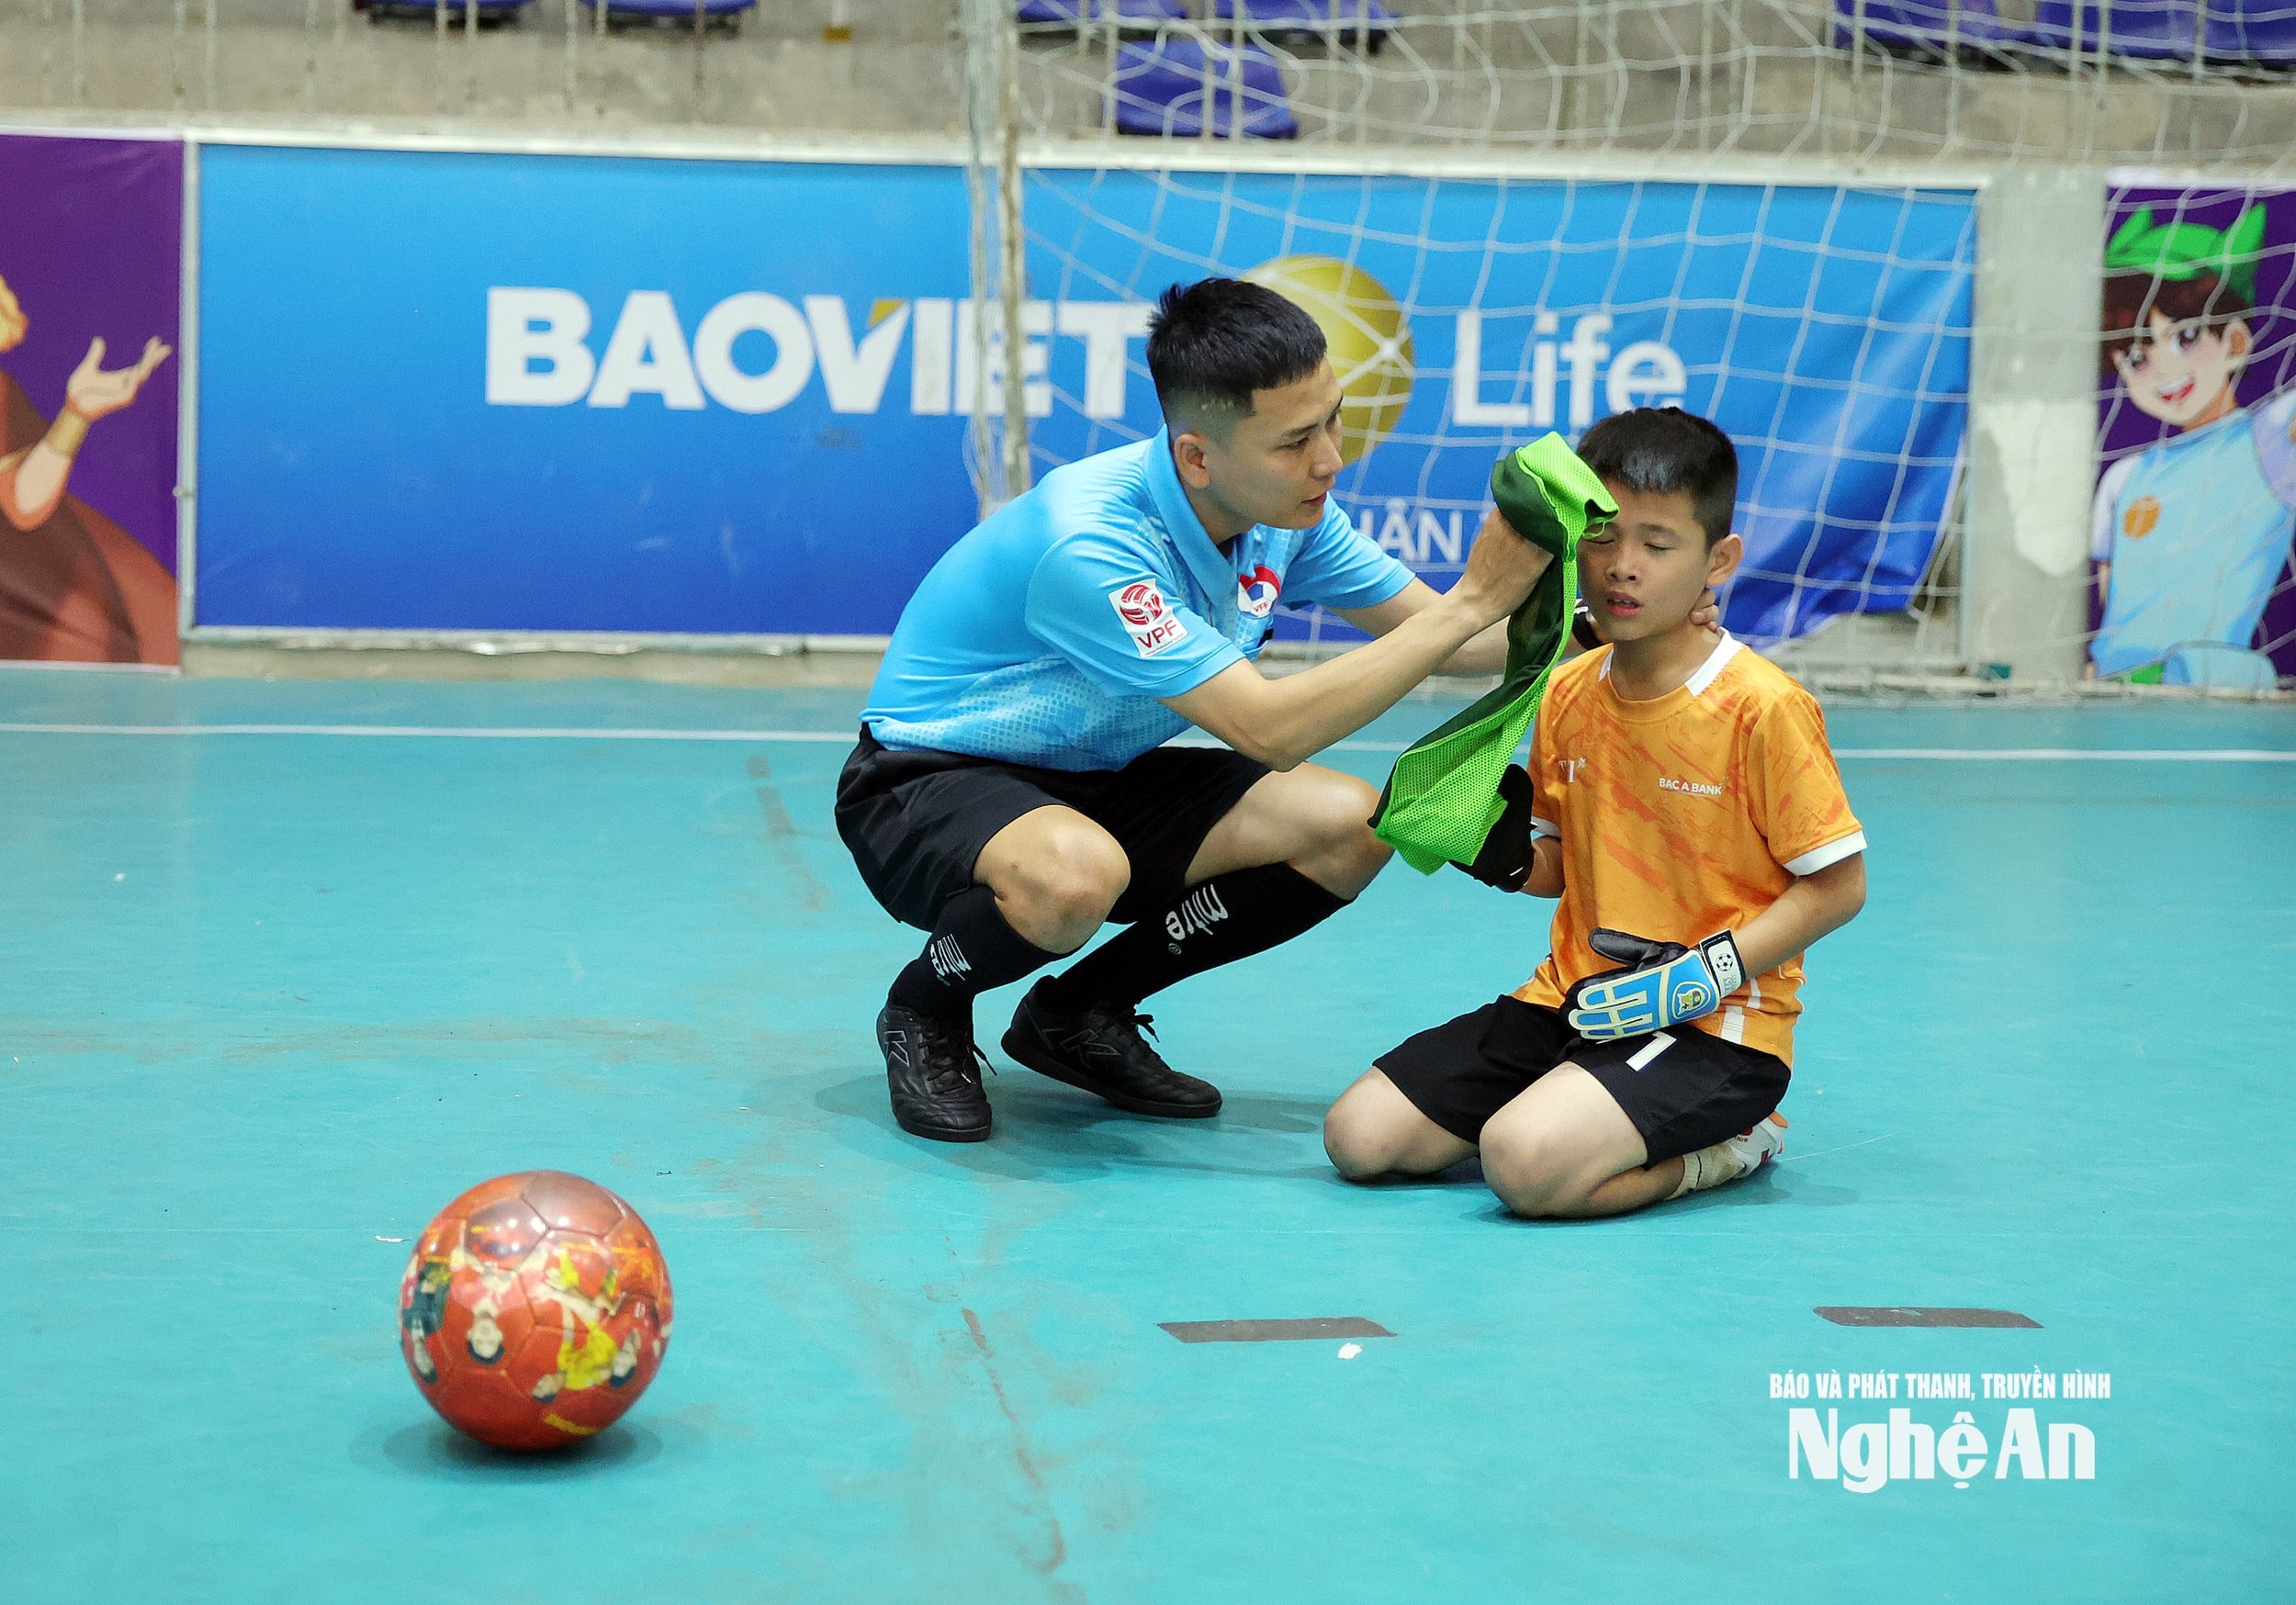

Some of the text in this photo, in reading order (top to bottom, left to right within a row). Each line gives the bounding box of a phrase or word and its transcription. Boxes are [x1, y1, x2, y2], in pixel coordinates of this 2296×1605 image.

[485, 286, 1686, 426] BAOVIET Life
[1137, 619, 1176, 648] VPF
[1691, 782, 1723, 795] BANK
